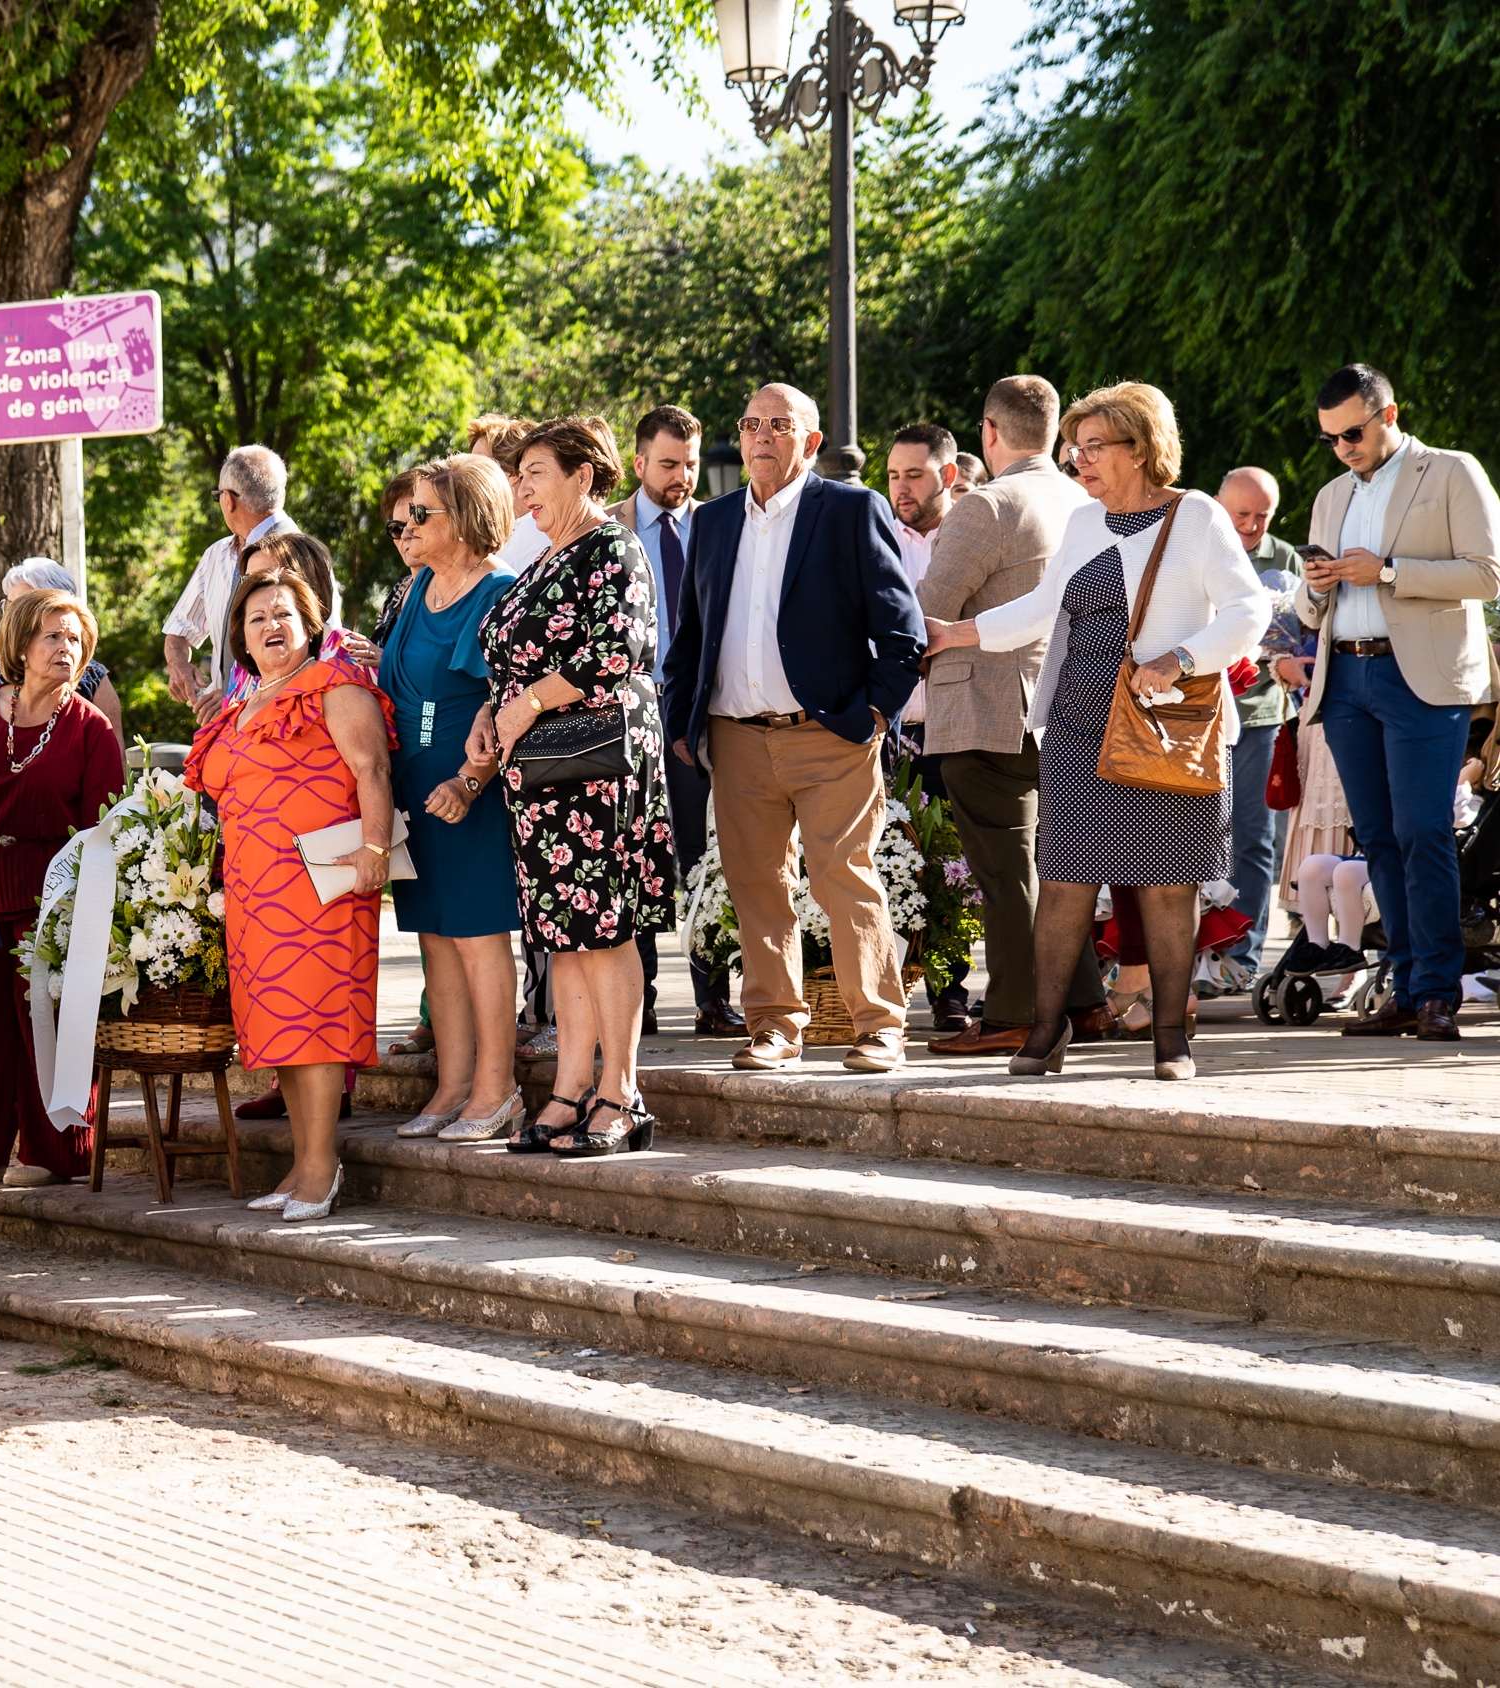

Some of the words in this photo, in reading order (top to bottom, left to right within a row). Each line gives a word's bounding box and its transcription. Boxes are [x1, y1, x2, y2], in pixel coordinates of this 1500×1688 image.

[5, 346, 62, 367] Zona
[68, 341, 120, 362] libre
[29, 366, 132, 391] violencia
[7, 399, 36, 419] de
[41, 394, 121, 421] género
